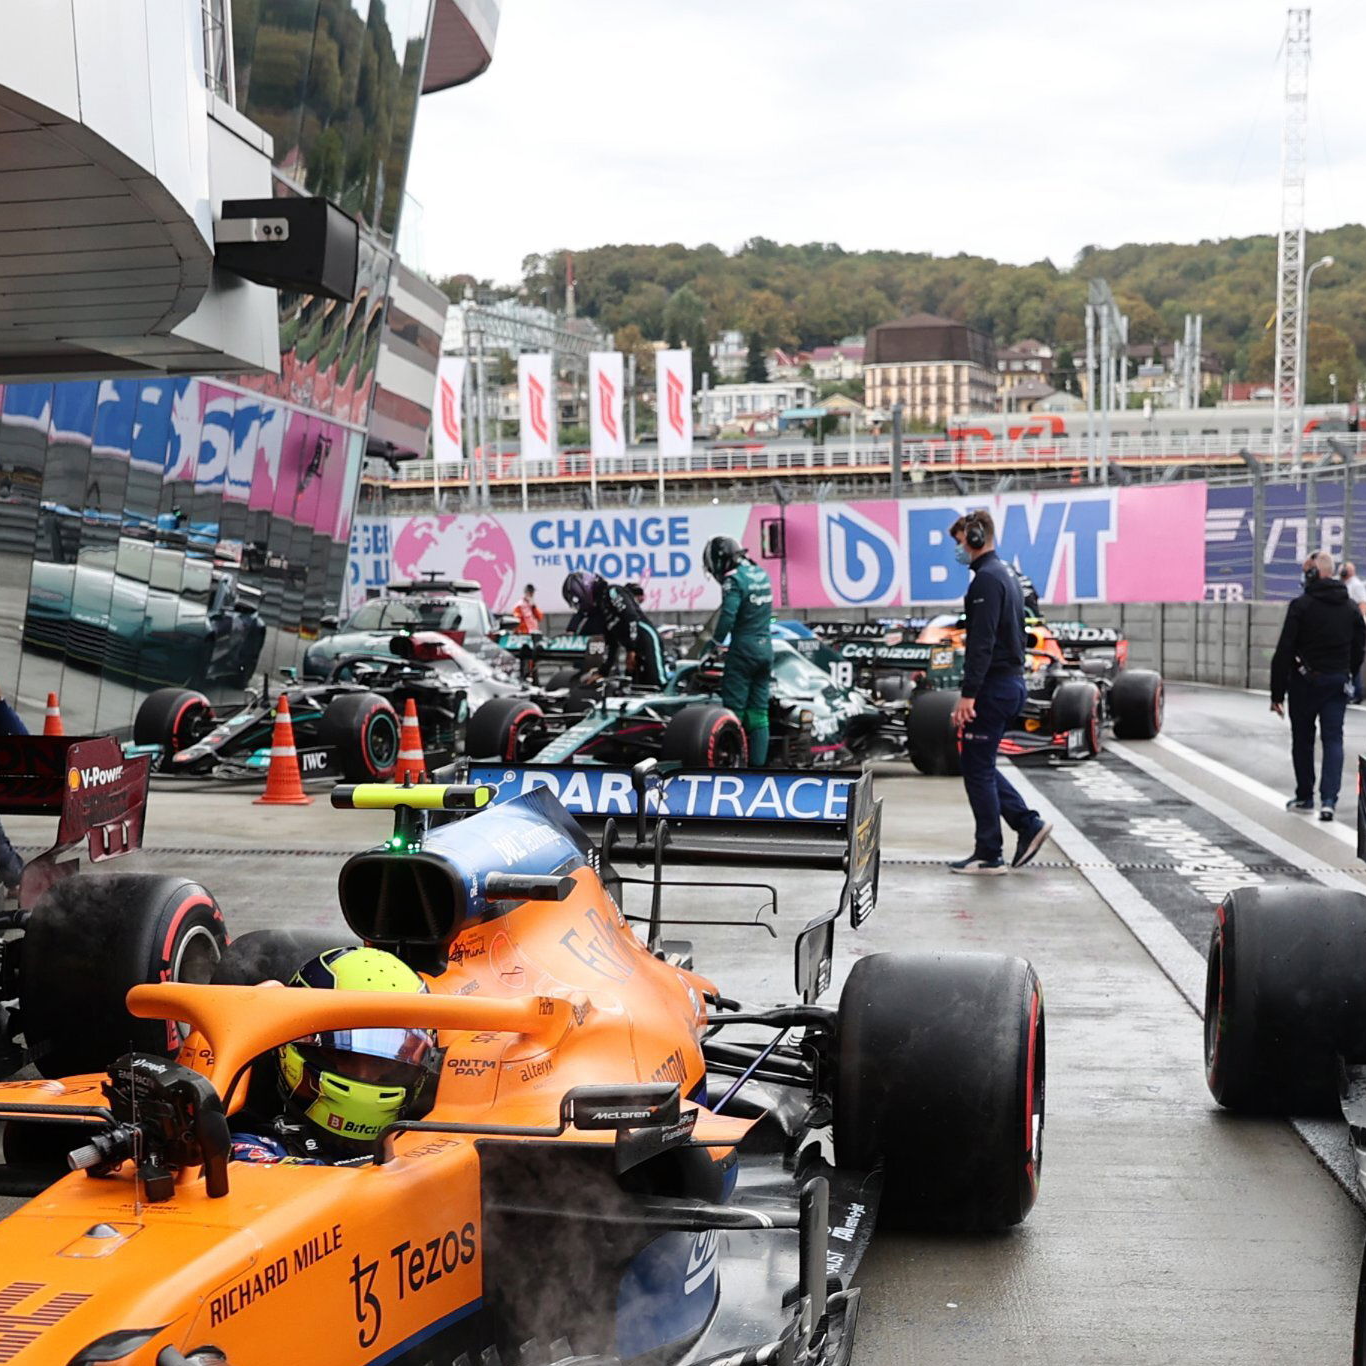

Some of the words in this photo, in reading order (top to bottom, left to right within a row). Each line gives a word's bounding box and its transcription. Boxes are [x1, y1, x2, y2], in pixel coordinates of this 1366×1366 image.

[531, 516, 689, 549] CHANGE
[533, 554, 561, 566] THE
[565, 552, 692, 580] WORLD
[828, 661, 853, 688] 18
[302, 751, 327, 771] IWC
[521, 770, 847, 821] DARKTRACE
[447, 1058, 497, 1070] QNTM
[454, 1066, 485, 1078] PAY
[521, 1058, 555, 1082] alteryx
[592, 1109, 651, 1121] McLaren
[391, 1221, 476, 1300] Tezos
[210, 1255, 291, 1328] RICHARD
[292, 1224, 343, 1274] MILLE
